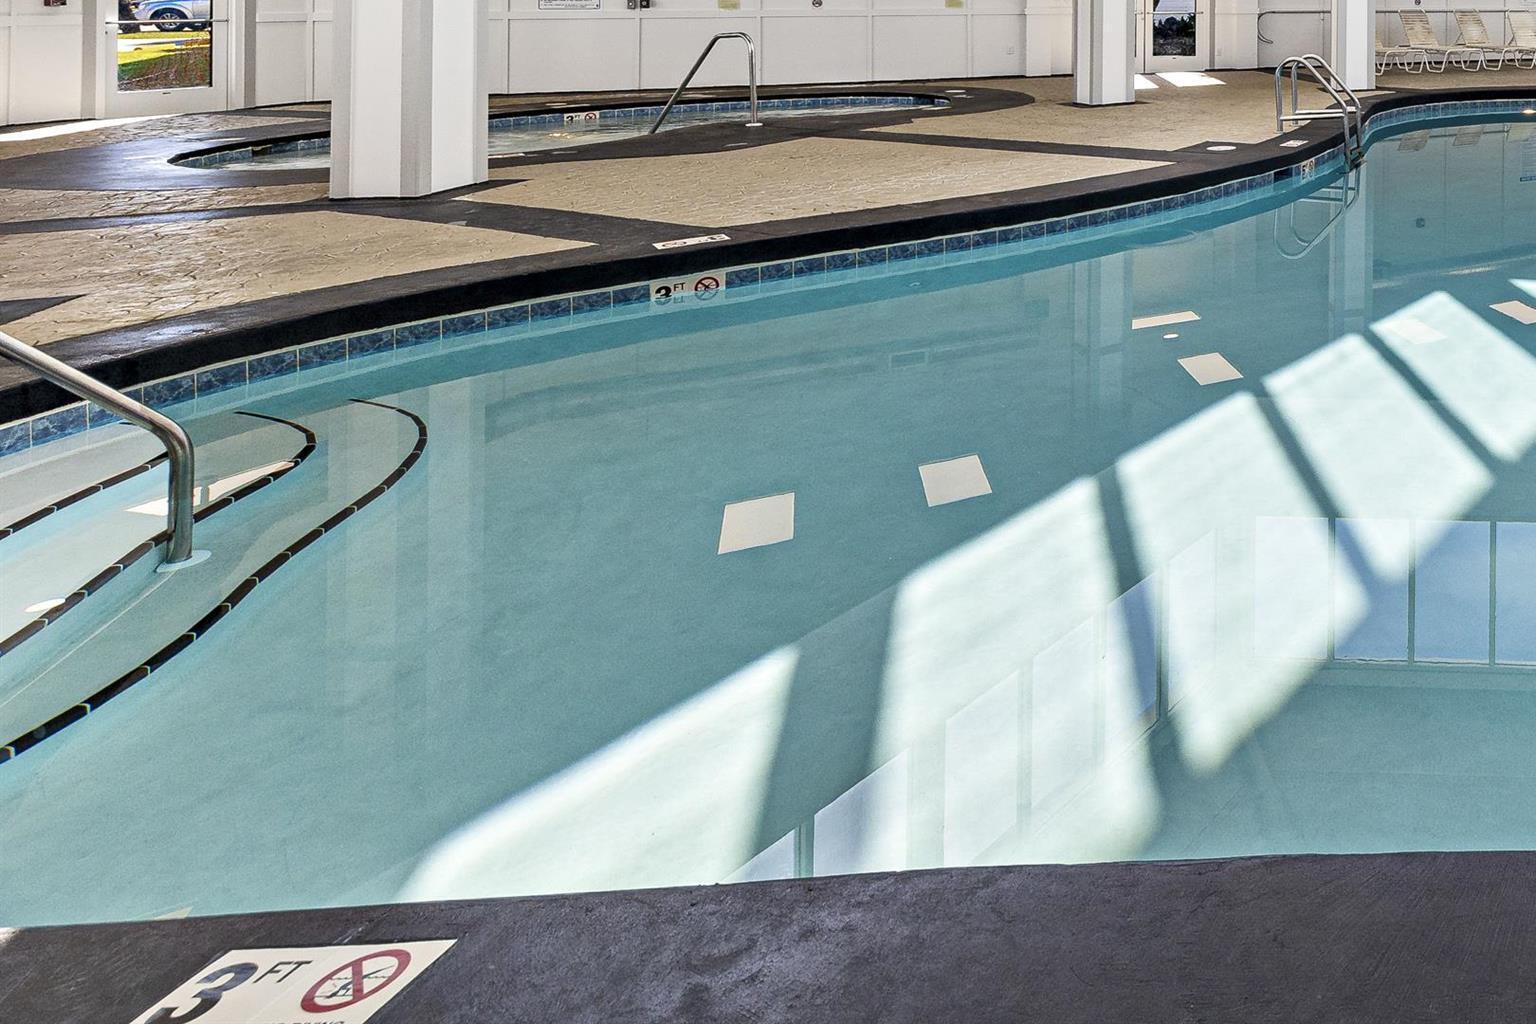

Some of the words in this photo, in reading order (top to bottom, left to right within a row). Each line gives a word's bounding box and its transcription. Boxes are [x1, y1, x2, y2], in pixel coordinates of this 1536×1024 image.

[674, 282, 686, 292] FT
[143, 962, 259, 1024] 3
[252, 960, 313, 984] FT
